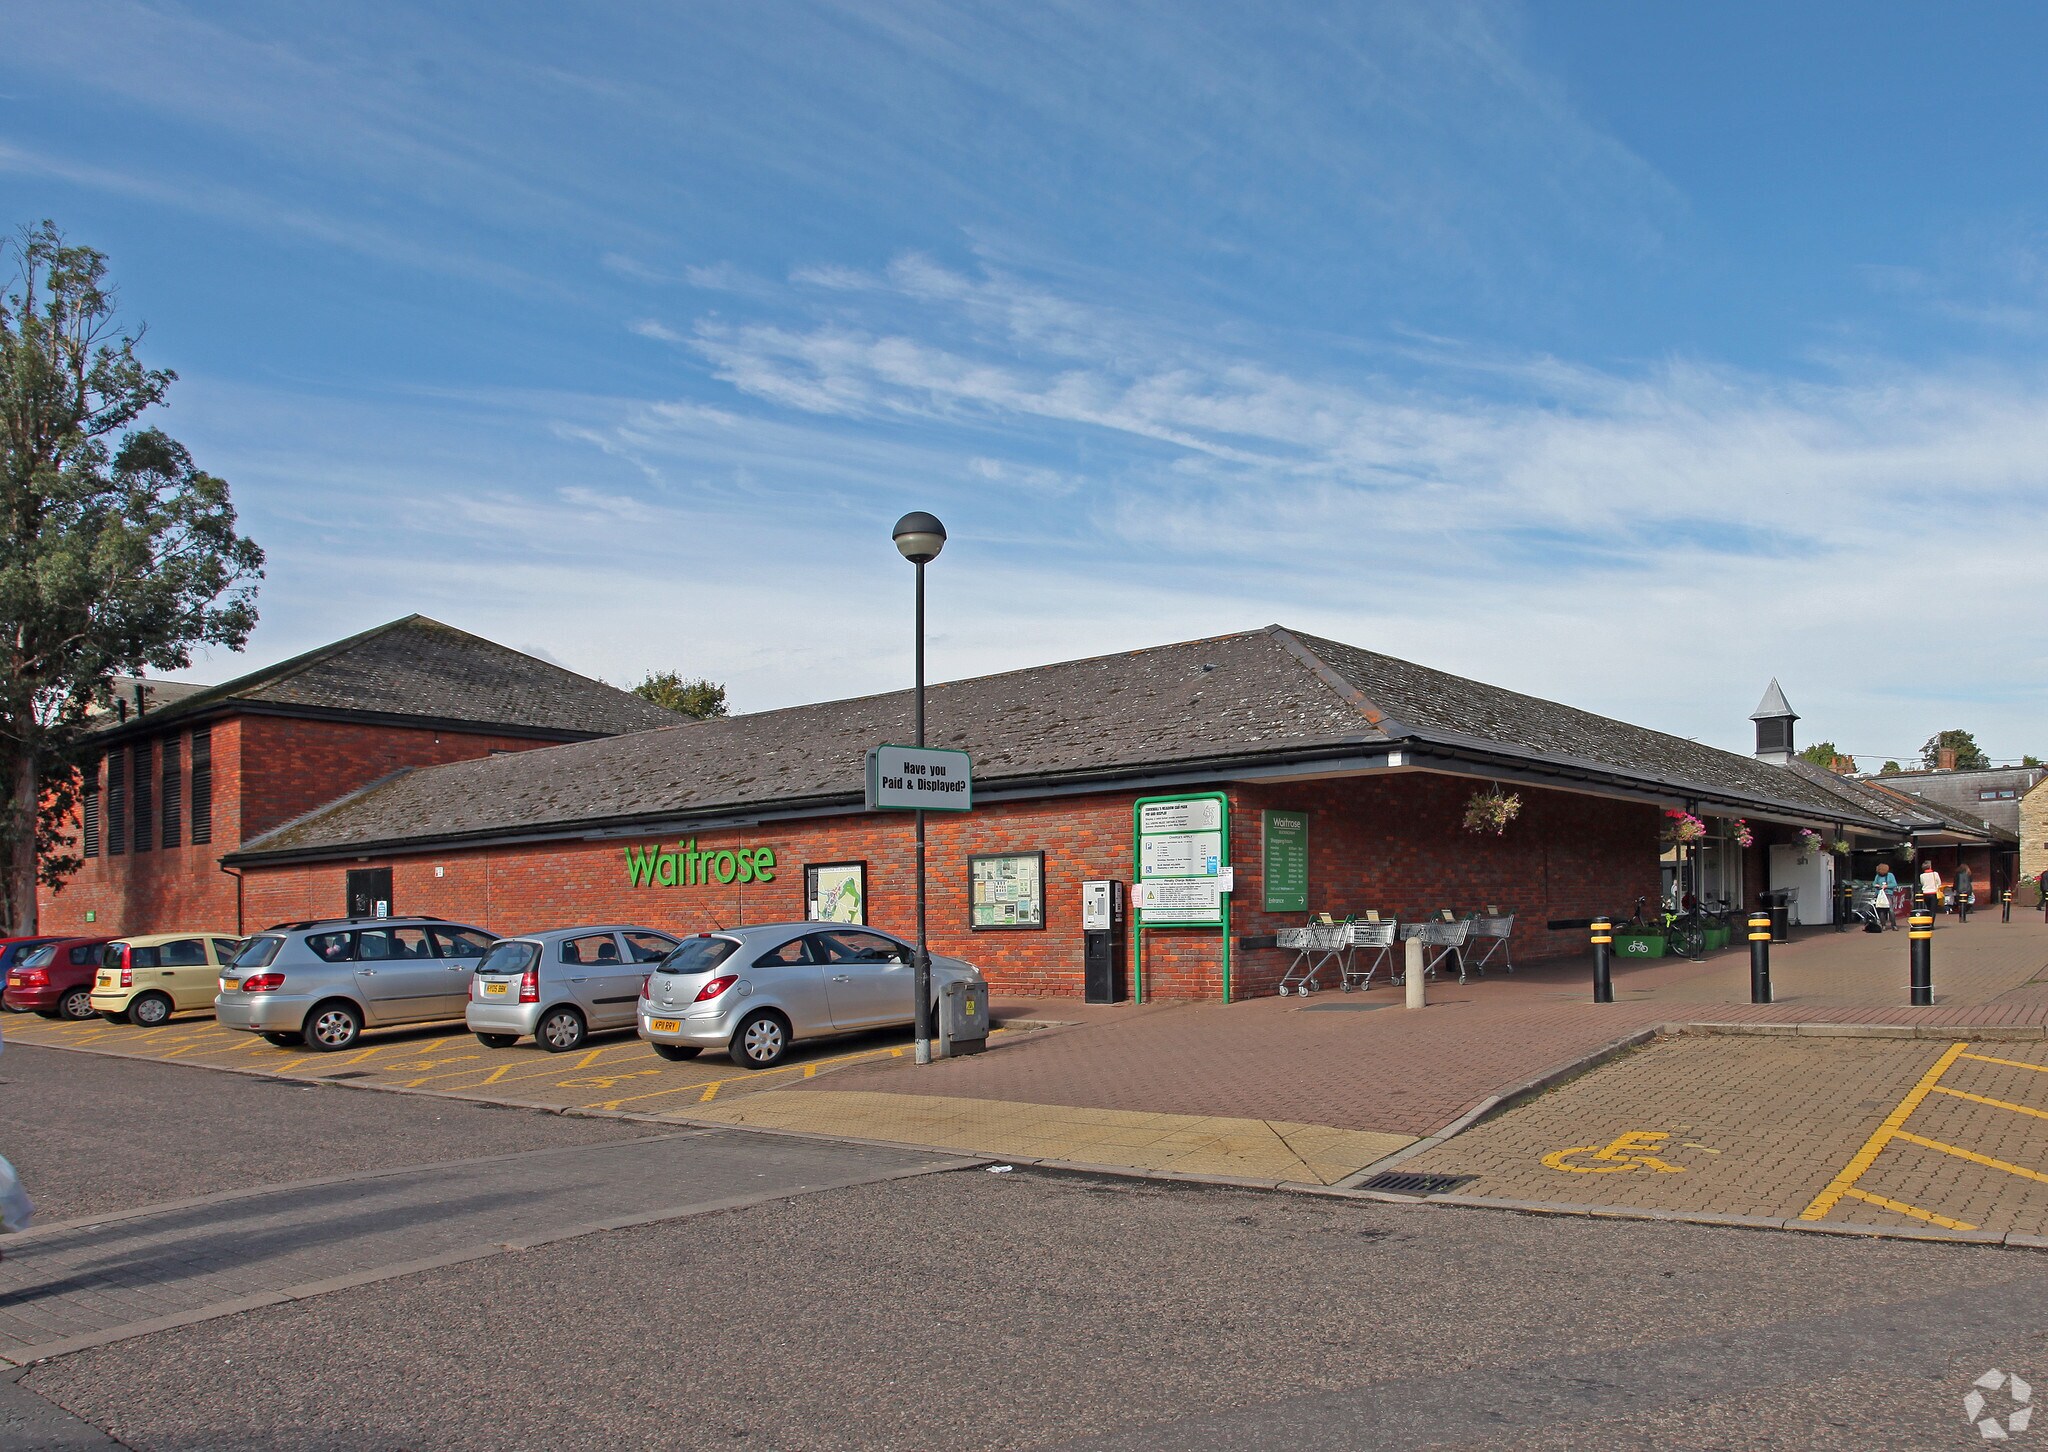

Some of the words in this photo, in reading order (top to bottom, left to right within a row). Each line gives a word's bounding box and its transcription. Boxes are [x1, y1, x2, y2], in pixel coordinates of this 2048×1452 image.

[904, 761, 926, 775] Have
[930, 765, 946, 777] you
[882, 776, 903, 789] Paid
[907, 780, 914, 790] &
[918, 778, 966, 793] Displayed?
[1273, 817, 1301, 828] Waitrose
[623, 836, 777, 888] Waitrose
[665, 1021, 677, 1031] RRY
